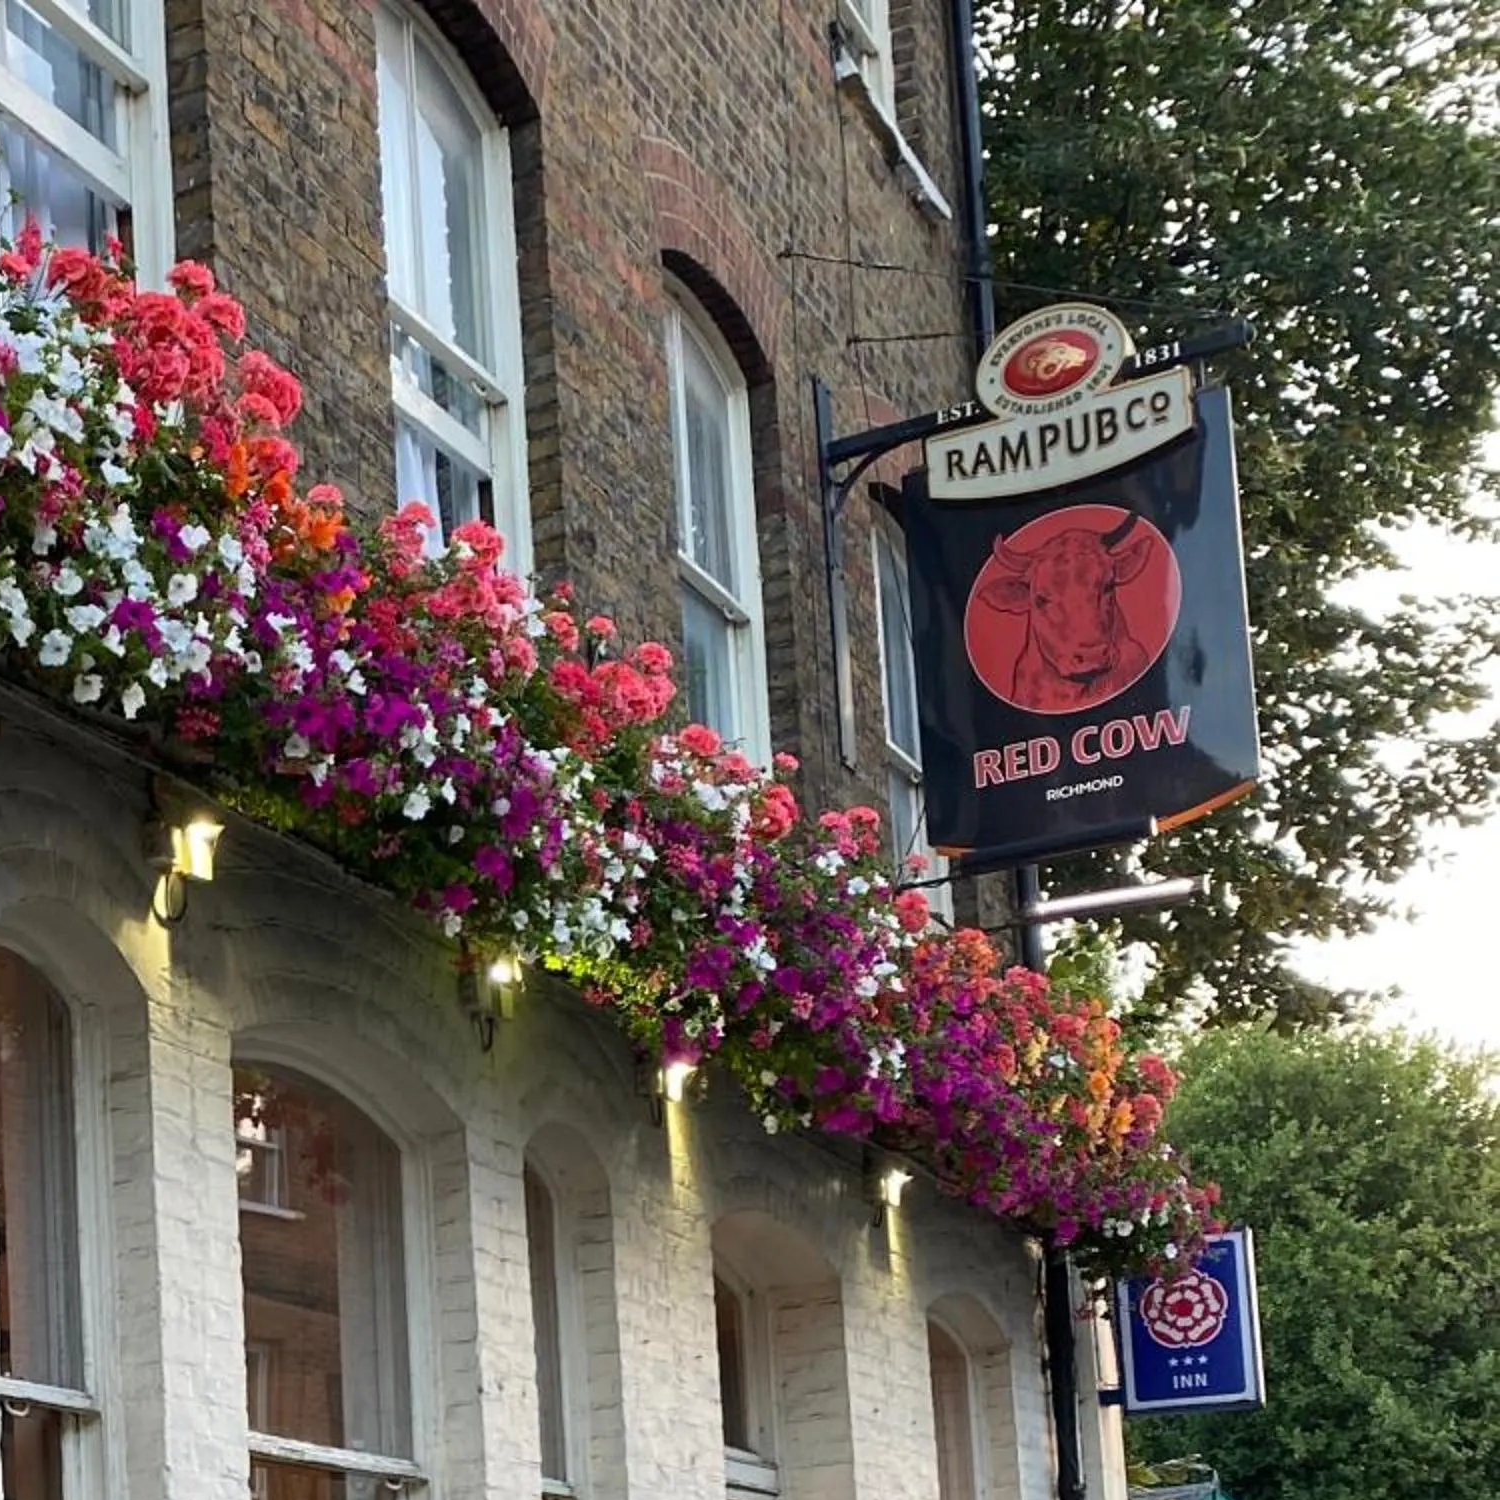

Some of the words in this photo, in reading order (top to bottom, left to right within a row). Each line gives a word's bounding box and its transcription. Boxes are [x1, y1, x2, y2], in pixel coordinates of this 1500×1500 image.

[1067, 313, 1107, 336] LOCAL
[936, 401, 981, 425] EST.
[1133, 341, 1182, 369] 1831
[972, 736, 1062, 789] RED
[1071, 705, 1192, 765] COW
[1045, 775, 1124, 801] RICHMOND
[1173, 1372, 1207, 1389] INN
